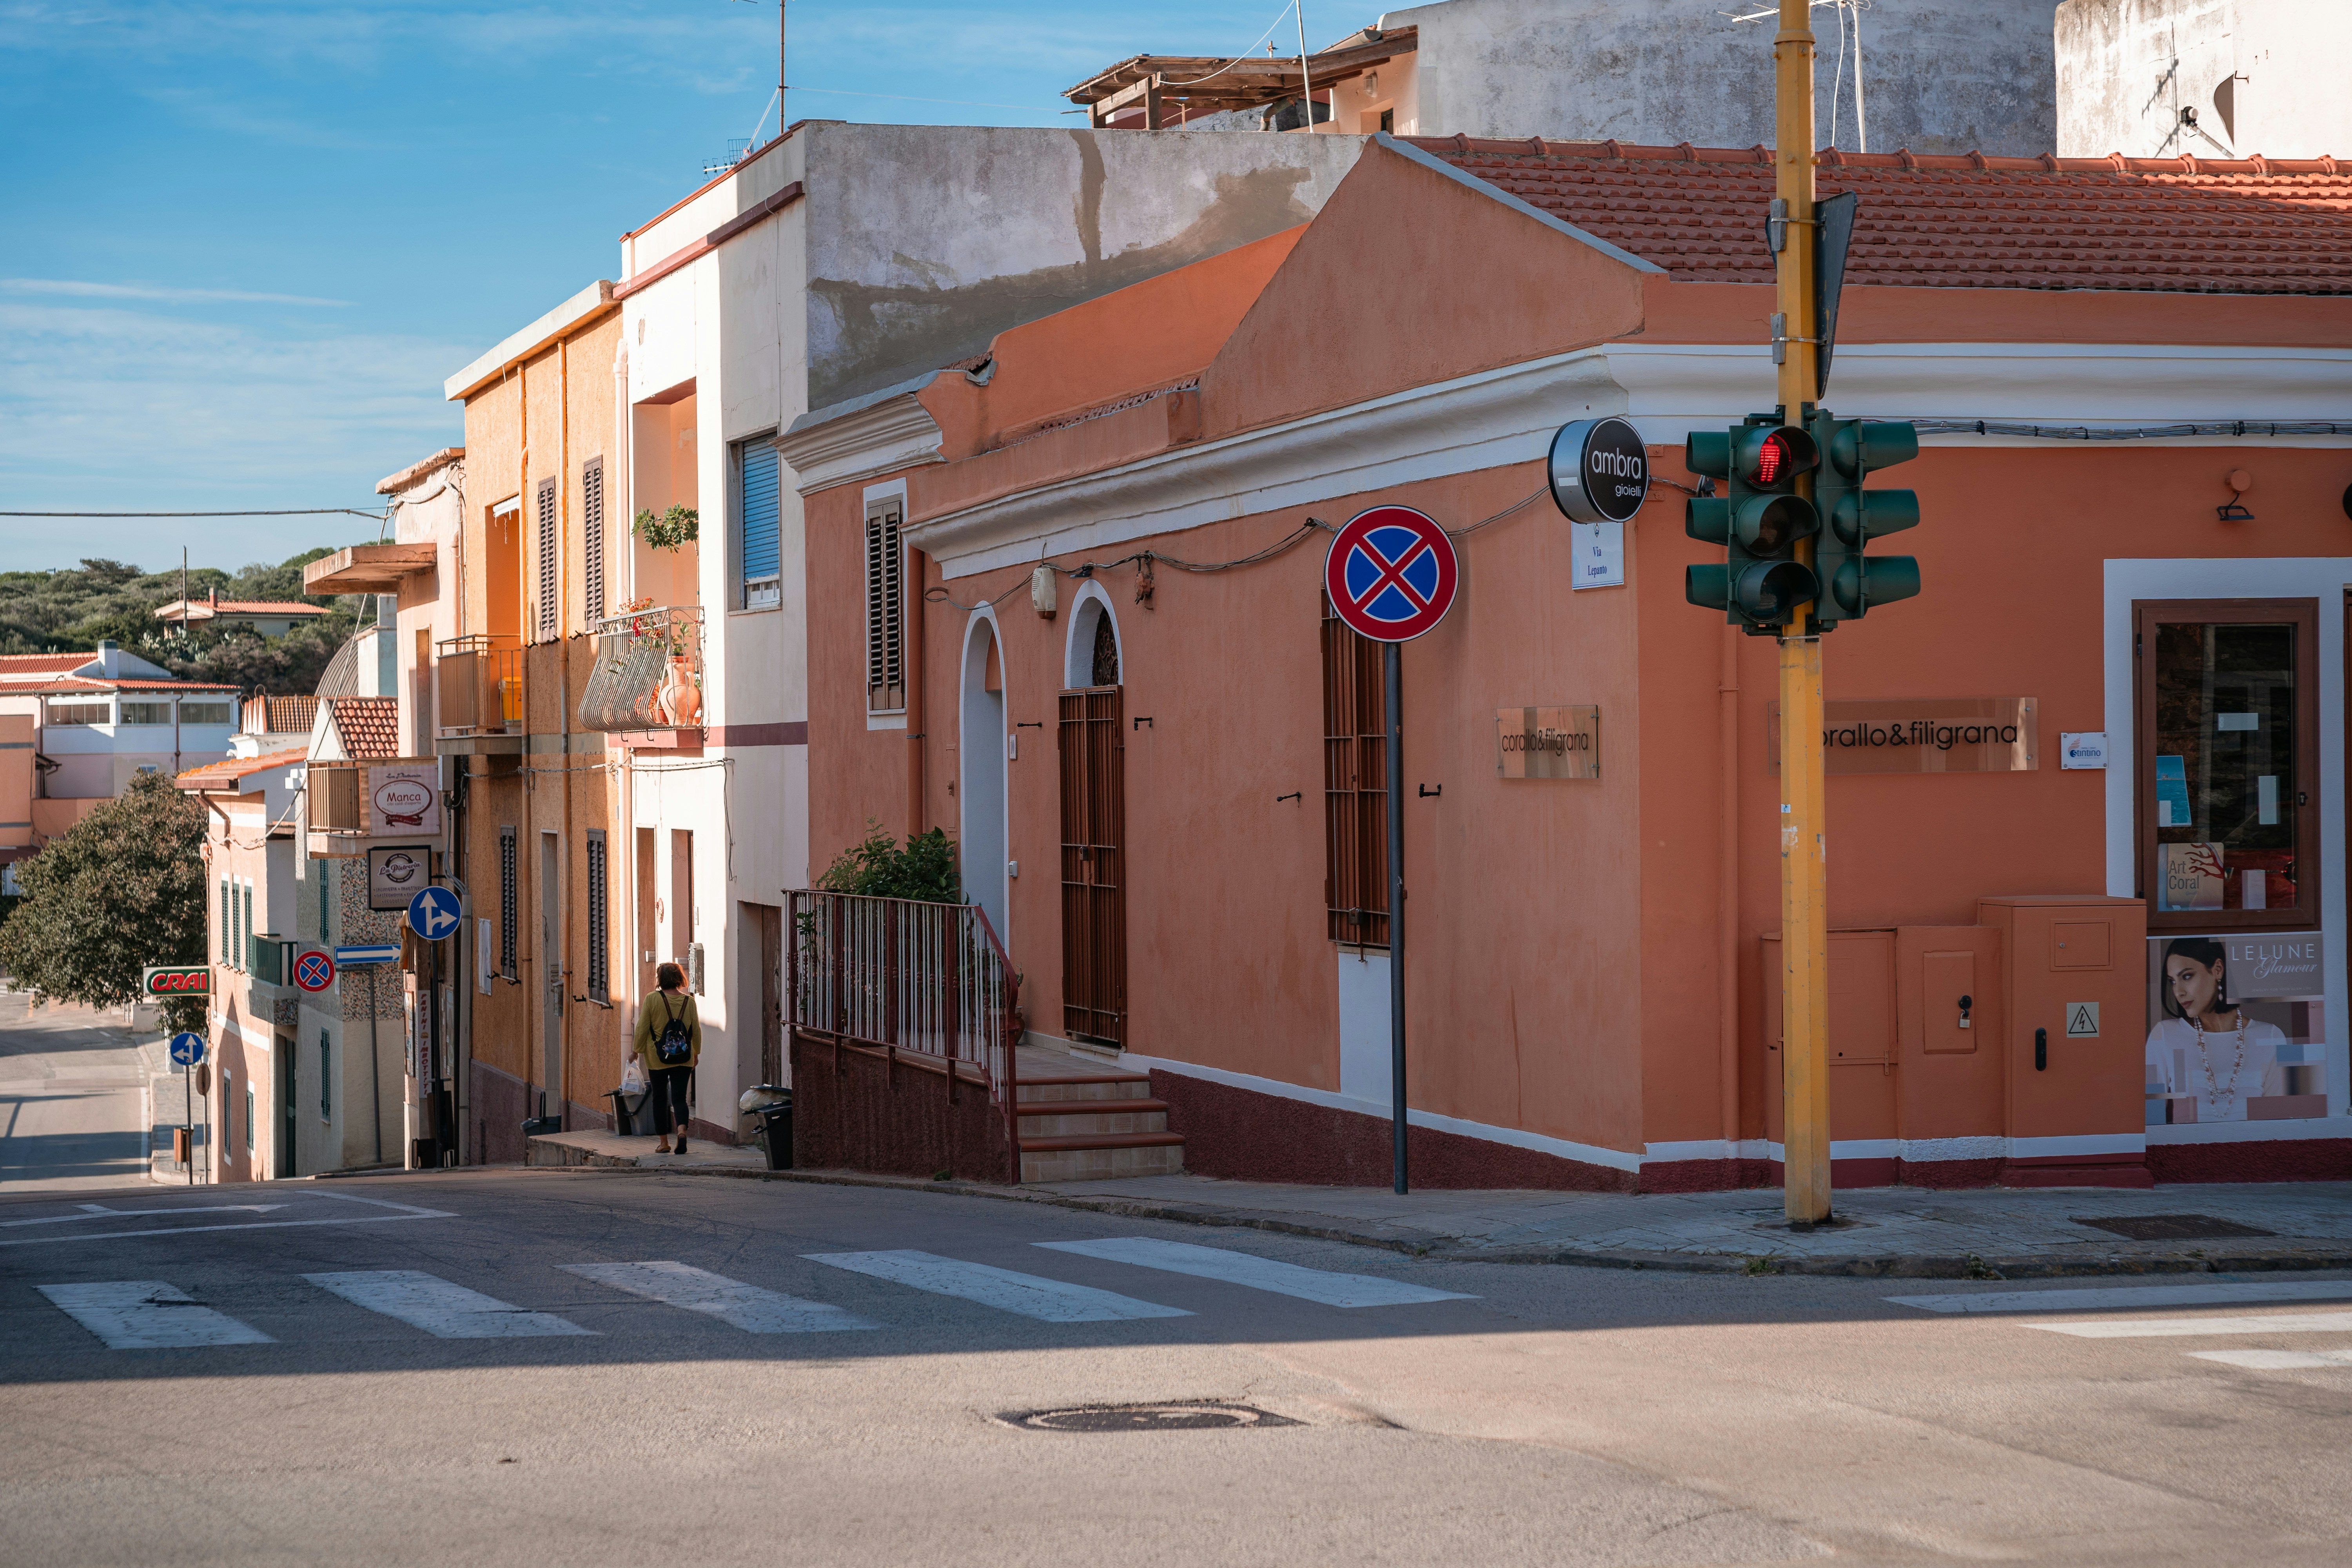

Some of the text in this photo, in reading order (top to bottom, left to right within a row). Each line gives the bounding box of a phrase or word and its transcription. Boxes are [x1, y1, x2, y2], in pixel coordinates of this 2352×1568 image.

[1592, 448, 1641, 479] ambra
[1615, 484, 1641, 497] gioielli
[1593, 546, 1601, 557] Via
[1588, 565, 1607, 578] Lepanto
[1502, 728, 1588, 757] corallo&filigrana
[1823, 721, 2017, 750] rallo&filigrana
[1011, 740, 1014, 754] 10
[387, 792, 421, 802] Manca
[379, 862, 421, 875] La Pietreria
[2169, 860, 2186, 874] Art
[2169, 875, 2199, 889] Coral
[2232, 944, 2314, 960] LELUNE
[2254, 954, 2317, 979] Glamour
[151, 972, 207, 991] CRAI
[420, 1041, 428, 1095] IMBOTTITI
